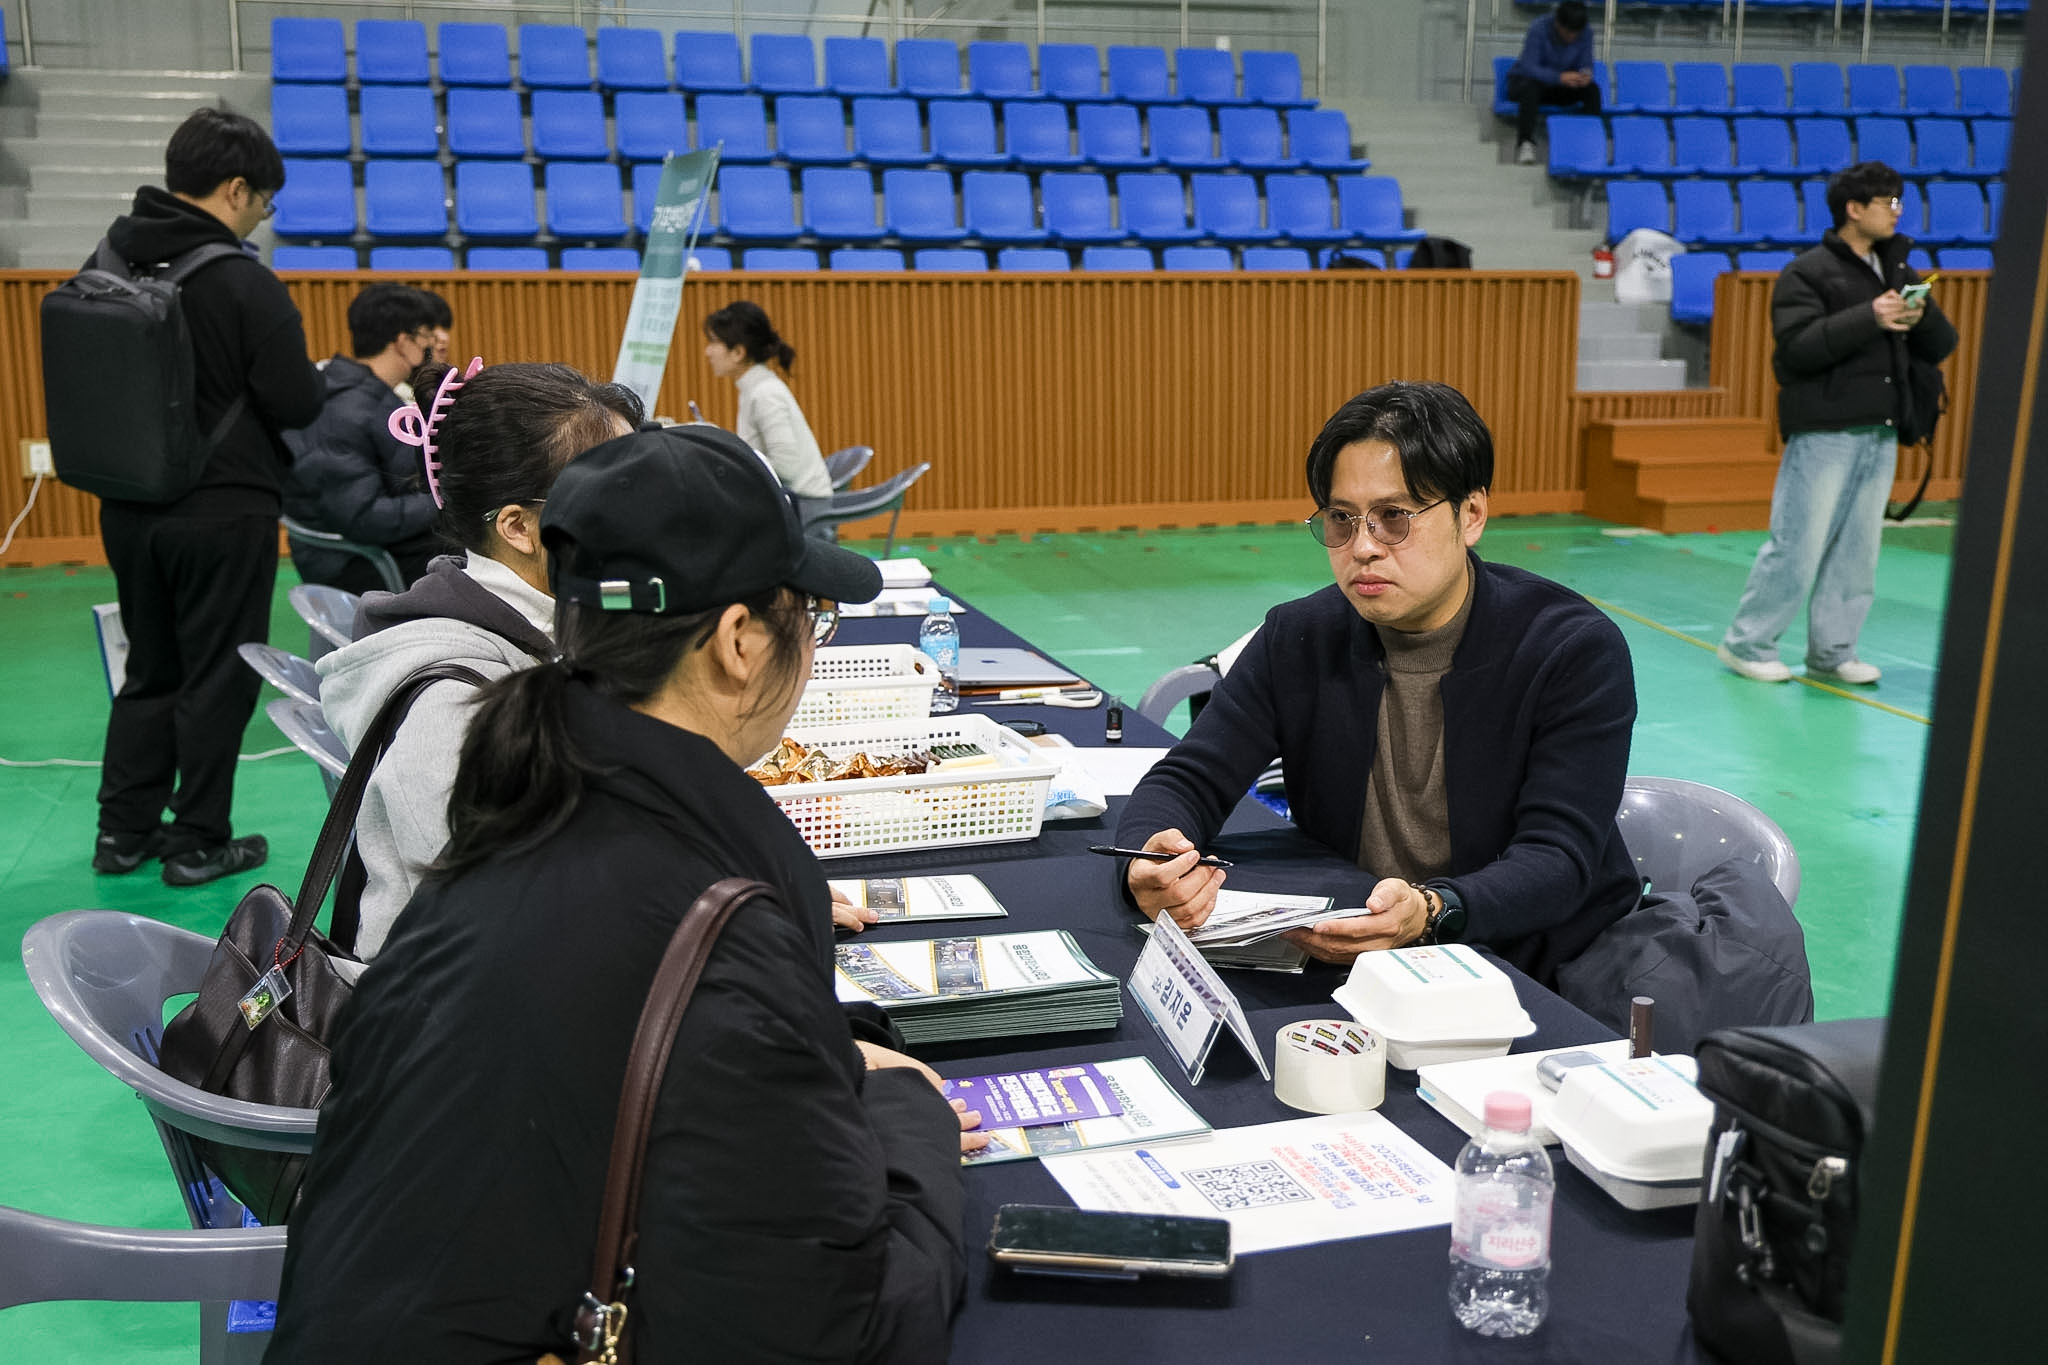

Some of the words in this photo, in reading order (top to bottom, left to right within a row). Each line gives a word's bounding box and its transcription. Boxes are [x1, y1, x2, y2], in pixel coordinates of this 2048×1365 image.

[1159, 976, 1193, 1031] 김지온
[1370, 1144, 1428, 1184] 2025학년도
[1372, 1161, 1419, 1193] Census
[1487, 1235, 1536, 1251] 지리산수
